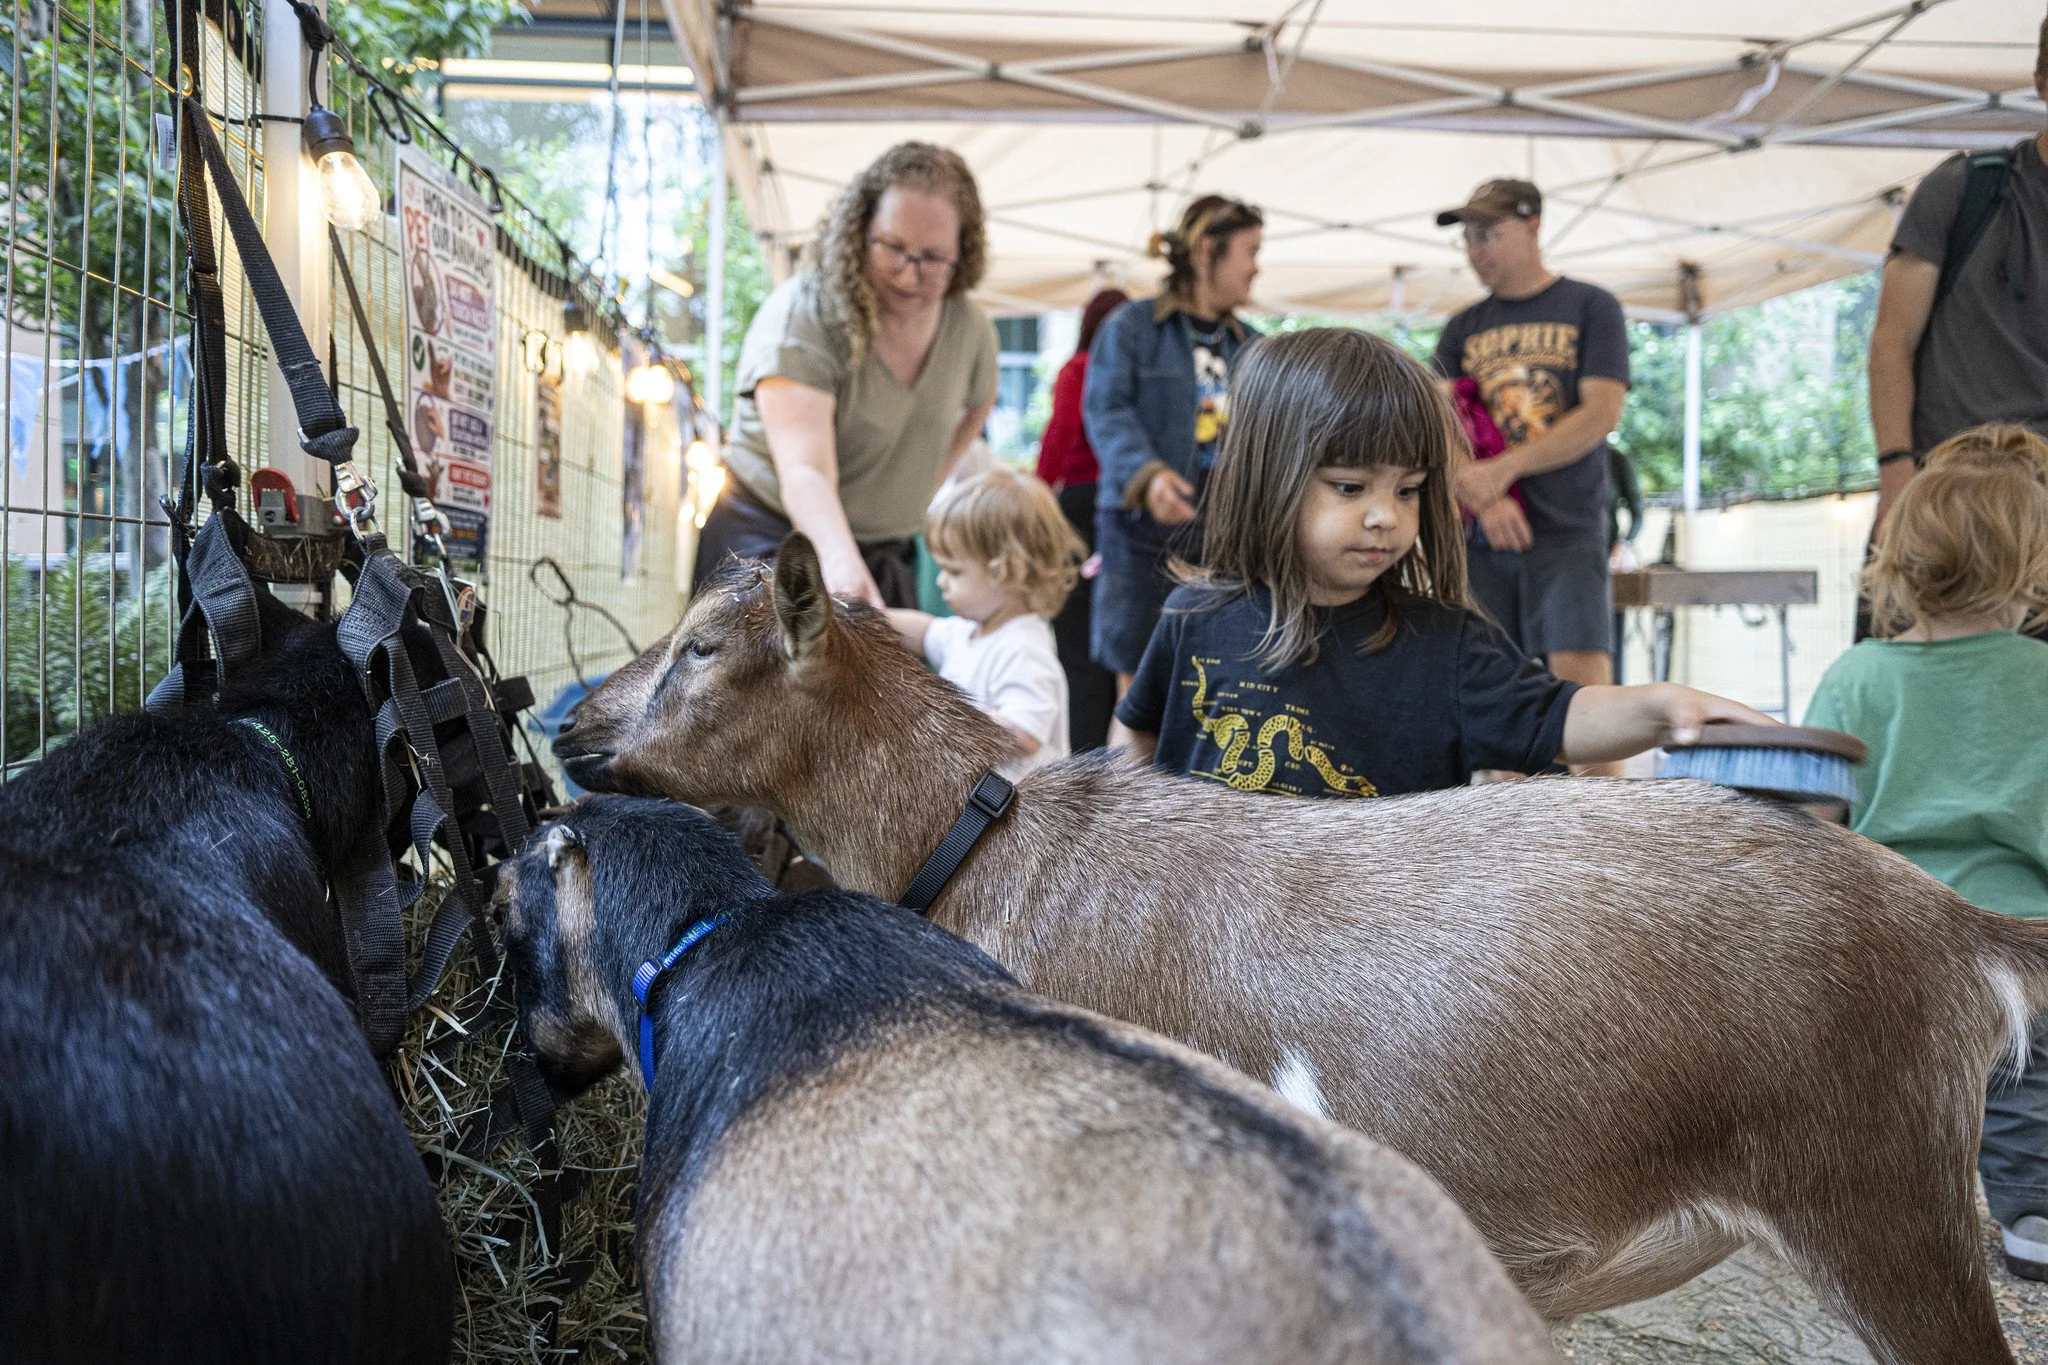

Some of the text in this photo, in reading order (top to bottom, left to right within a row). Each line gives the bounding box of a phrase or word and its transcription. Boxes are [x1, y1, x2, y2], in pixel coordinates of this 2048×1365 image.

[404, 204, 431, 250] PET
[423, 187, 464, 233] HOW TO
[1461, 322, 1579, 371] SOPHIE
[1257, 683, 1279, 694] CITY
